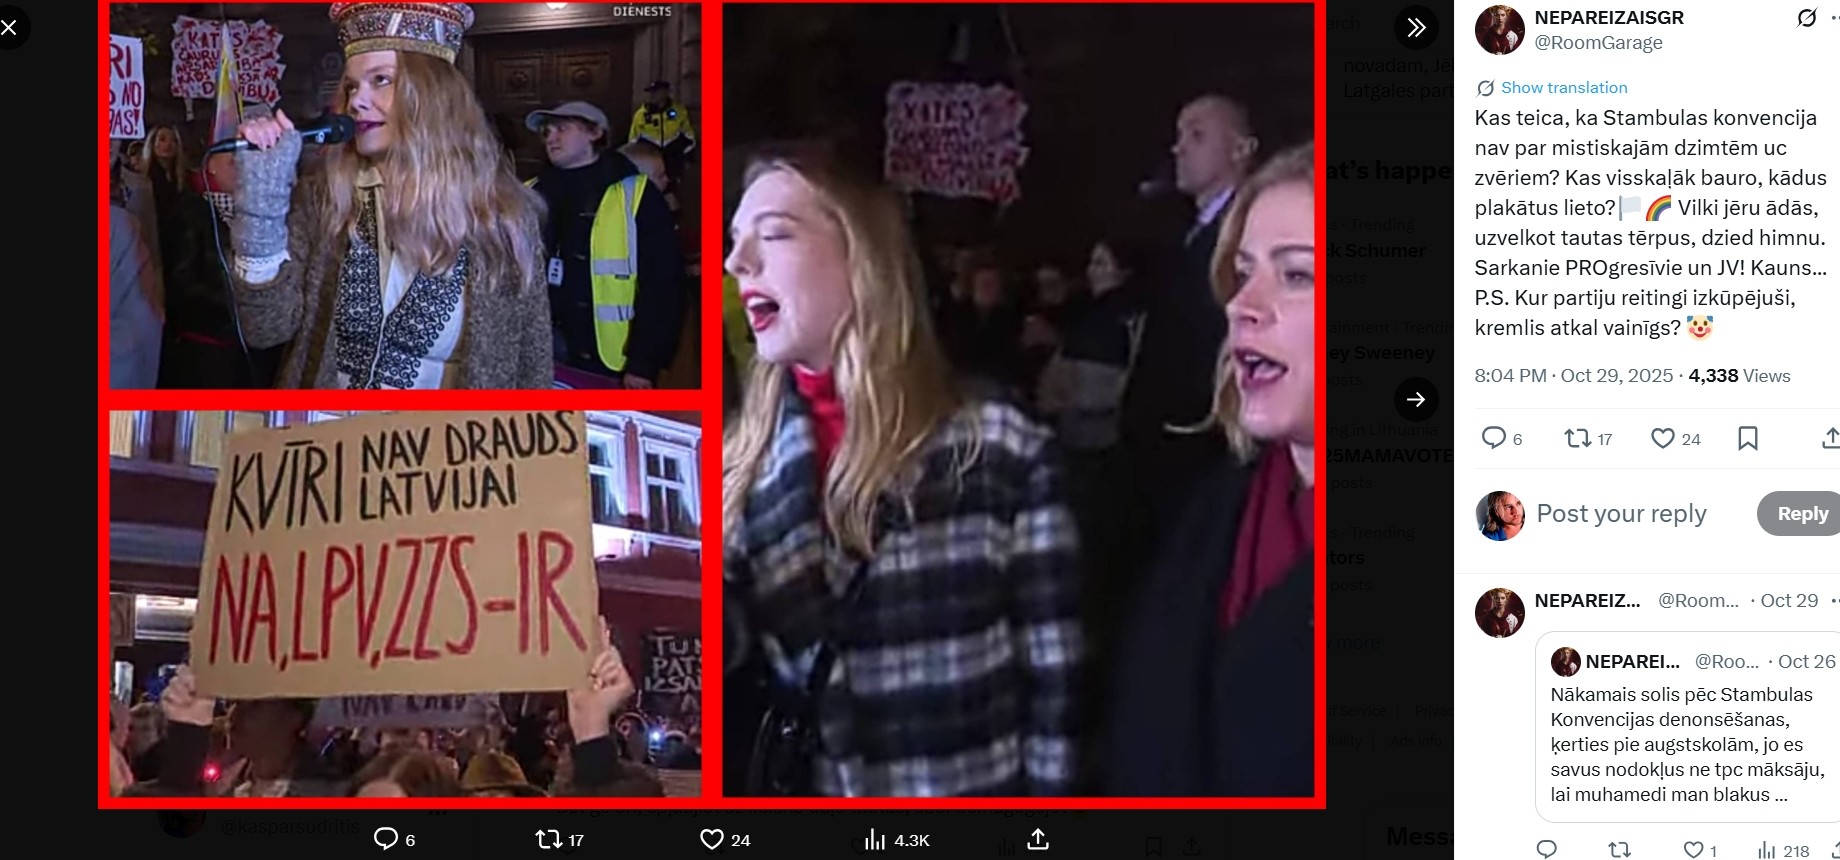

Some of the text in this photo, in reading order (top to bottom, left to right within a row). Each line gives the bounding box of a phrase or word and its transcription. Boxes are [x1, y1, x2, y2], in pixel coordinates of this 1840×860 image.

[1536, 11, 1684, 24] NEPAREIZAISGR
[188, 30, 243, 49] KATS
[1535, 35, 1662, 53] @RoomGarage
[178, 49, 240, 62] CAURUS
[122, 81, 141, 107] NO
[1502, 81, 1627, 93] Show translation
[1476, 109, 1816, 129] Kas teica, ka Stambulas konvencija
[1476, 139, 1786, 159] nav par mistiskajām dzimtēm uc
[1475, 169, 1826, 189] zvēriem? Kas visskaļāk bauro, kādus
[1476, 199, 1818, 219] plakātus lieto? Vilki jēru ādās,
[1476, 229, 1825, 249] uzvelkot tautas tērpus, dzied himnu.
[1346, 243, 1426, 258] Schumer
[1475, 259, 1559, 275] Sarkanie
[1566, 259, 1682, 279] PROgresīvie
[1689, 264, 1711, 275] un
[1717, 260, 1744, 275] JV!
[1476, 289, 1795, 309] P.S. Kur partiju reitingi izkūpējuši,
[1476, 319, 1681, 339] kremlis atkal vainīgs?
[1354, 345, 1435, 363] Sweeney
[1475, 369, 1790, 385] 8:04 PM Oct 29, 2025 4,338 Views
[1514, 434, 1701, 445] 6 17 24
[225, 411, 579, 533] KVĪRI NAV DRAUDS
[360, 465, 518, 520] LATVIJAI
[1538, 503, 1707, 527] Post your reply
[1778, 506, 1829, 524] Reply
[1761, 594, 1792, 607] Oct
[1797, 594, 1818, 607] 29
[1779, 655, 1809, 668] Oct
[1814, 655, 1836, 668] 26
[1552, 687, 1812, 705] Nākamais solis pēc Stambulas
[1552, 712, 1789, 730] Konvencijas denonsēšanas,
[1552, 737, 1803, 755] ķerties pie augstskolām, jo es
[1551, 762, 1824, 780] savus nodokļus ne tpc māksāju,
[1552, 787, 1570, 801] lai
[1576, 787, 1666, 801] muhamedi
[1672, 791, 1708, 801] man
[1714, 787, 1769, 801] blakus
[405, 834, 931, 847] 6 17 24 4.3K
[1711, 846, 1809, 857] 1 218
